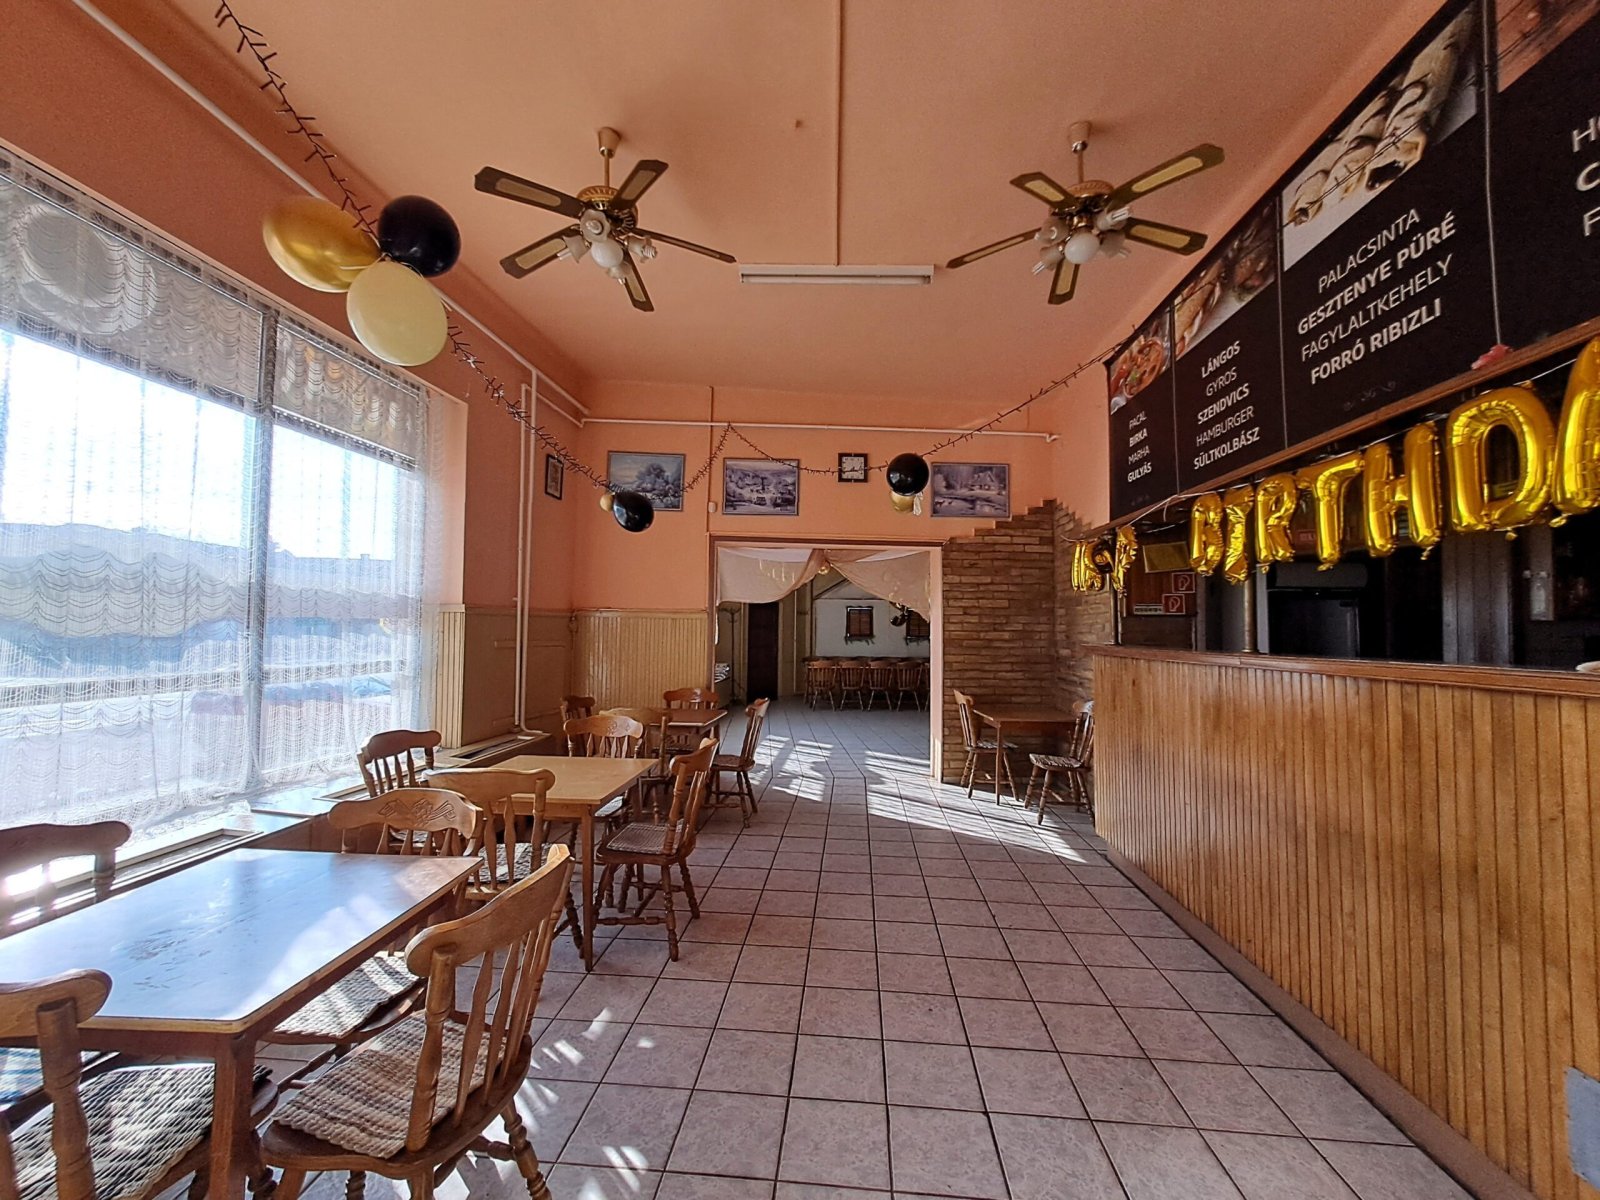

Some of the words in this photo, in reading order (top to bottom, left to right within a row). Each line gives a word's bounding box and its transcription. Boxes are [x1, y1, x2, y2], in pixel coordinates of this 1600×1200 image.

[1318, 208, 1420, 294] PALACSINTA
[1297, 258, 1393, 335] GESZTENYE
[1396, 210, 1456, 270] PÜRÉ
[1301, 252, 1453, 362] FAGYLALTKEHELY
[1201, 340, 1240, 378] LÁNGOS
[1310, 338, 1366, 385] FORRÓ
[1369, 297, 1442, 353] RIBIZLI
[1205, 366, 1237, 397] GYROS
[1197, 383, 1250, 425] SZENDVICS
[1129, 428, 1148, 448] BIRKA
[1196, 405, 1255, 447] HAMBURGER
[1193, 426, 1260, 470] SÜLTKOLBÁSZ
[1127, 462, 1152, 483] GULYÁS
